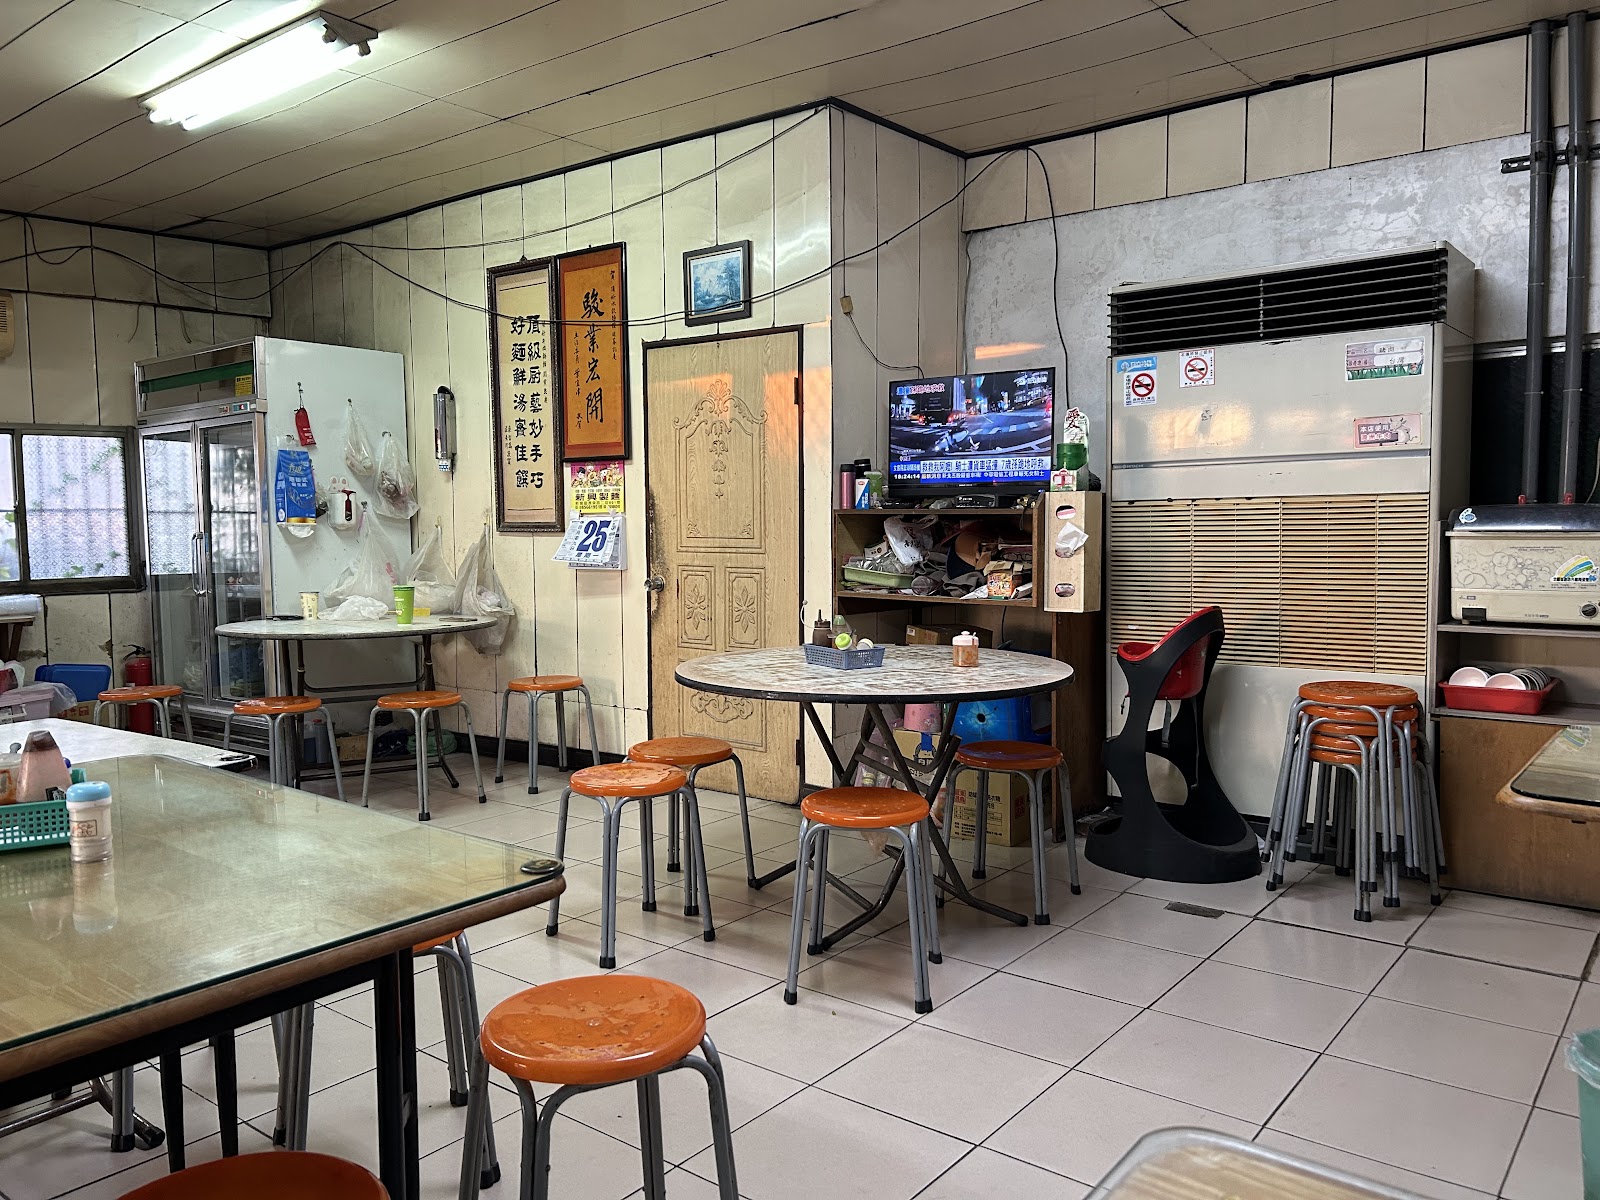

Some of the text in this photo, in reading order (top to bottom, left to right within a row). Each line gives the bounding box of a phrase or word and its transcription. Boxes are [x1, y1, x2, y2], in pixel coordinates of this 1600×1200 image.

[580, 287, 606, 424] 駿業宏開
[575, 519, 612, 552] 25
